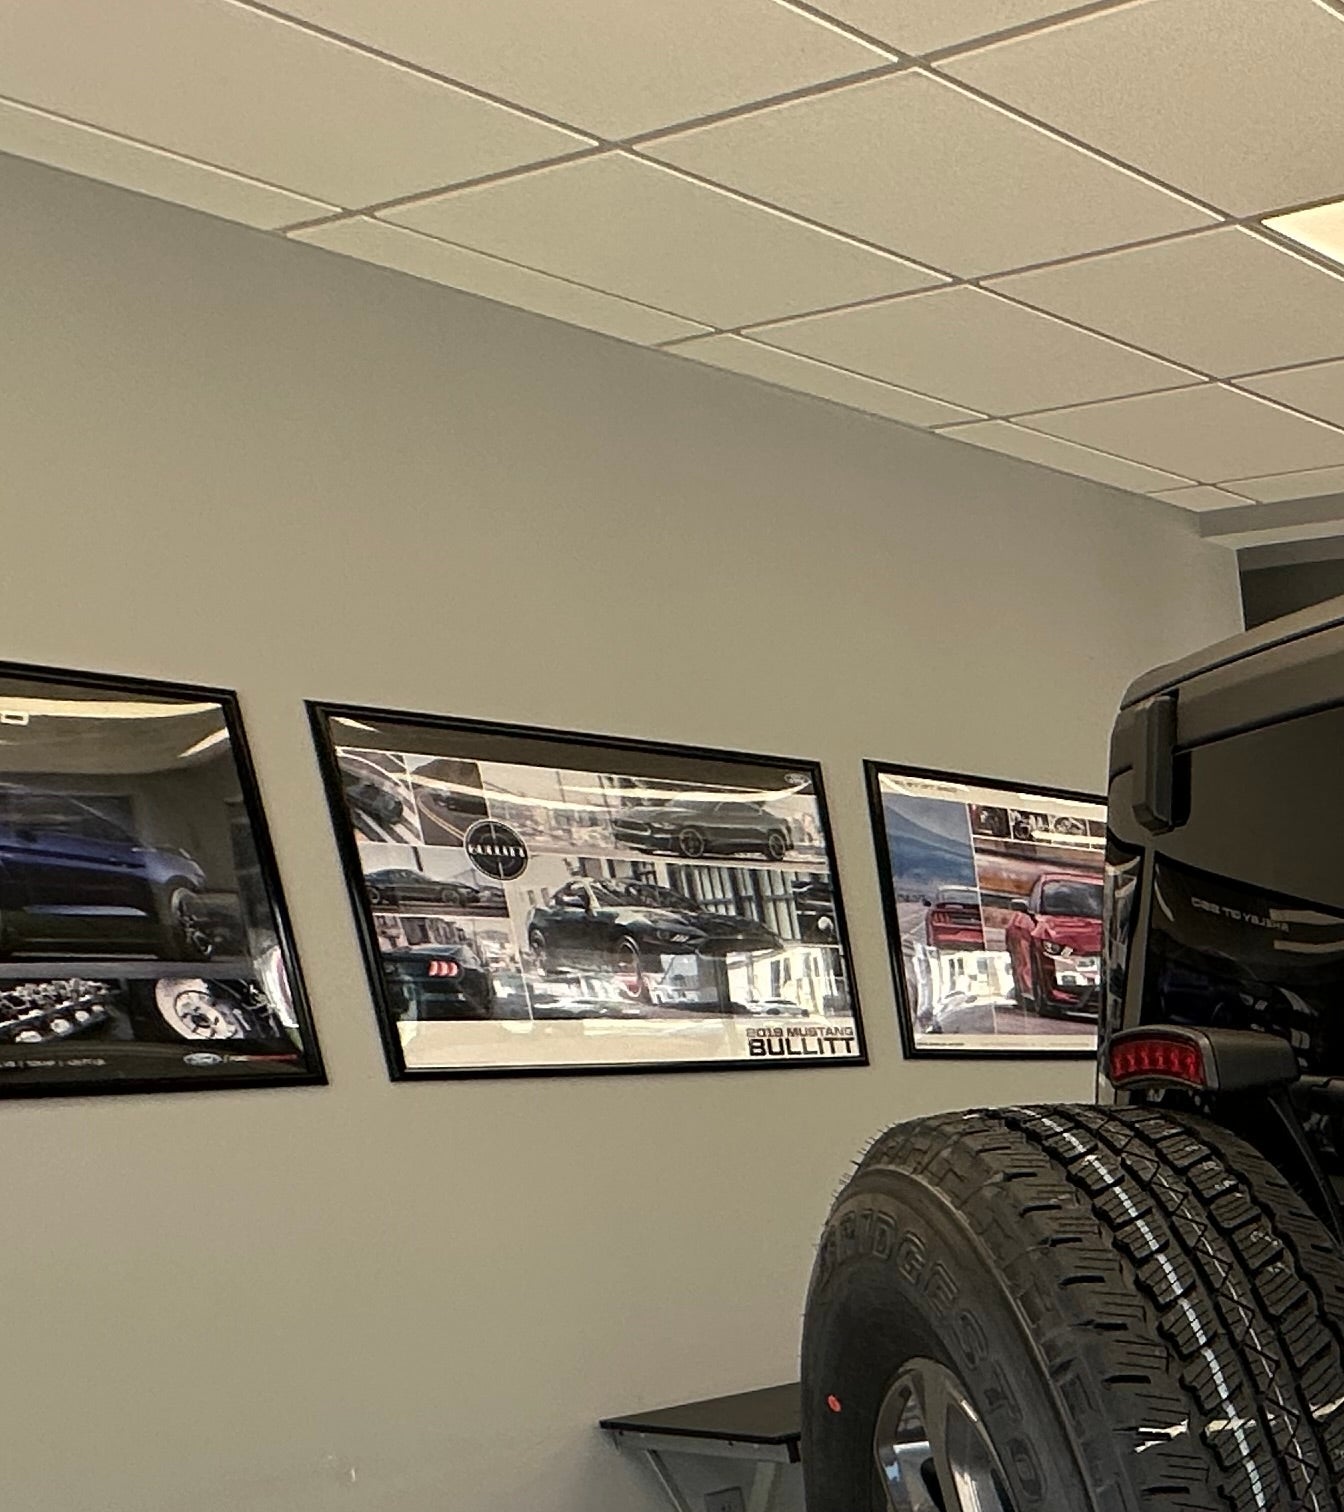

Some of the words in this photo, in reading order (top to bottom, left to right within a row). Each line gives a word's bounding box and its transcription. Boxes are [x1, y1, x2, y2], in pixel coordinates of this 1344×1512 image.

[746, 1027, 783, 1037] 2019
[786, 1026, 853, 1037] MUSTANG
[748, 1037, 855, 1056] BULLITT
